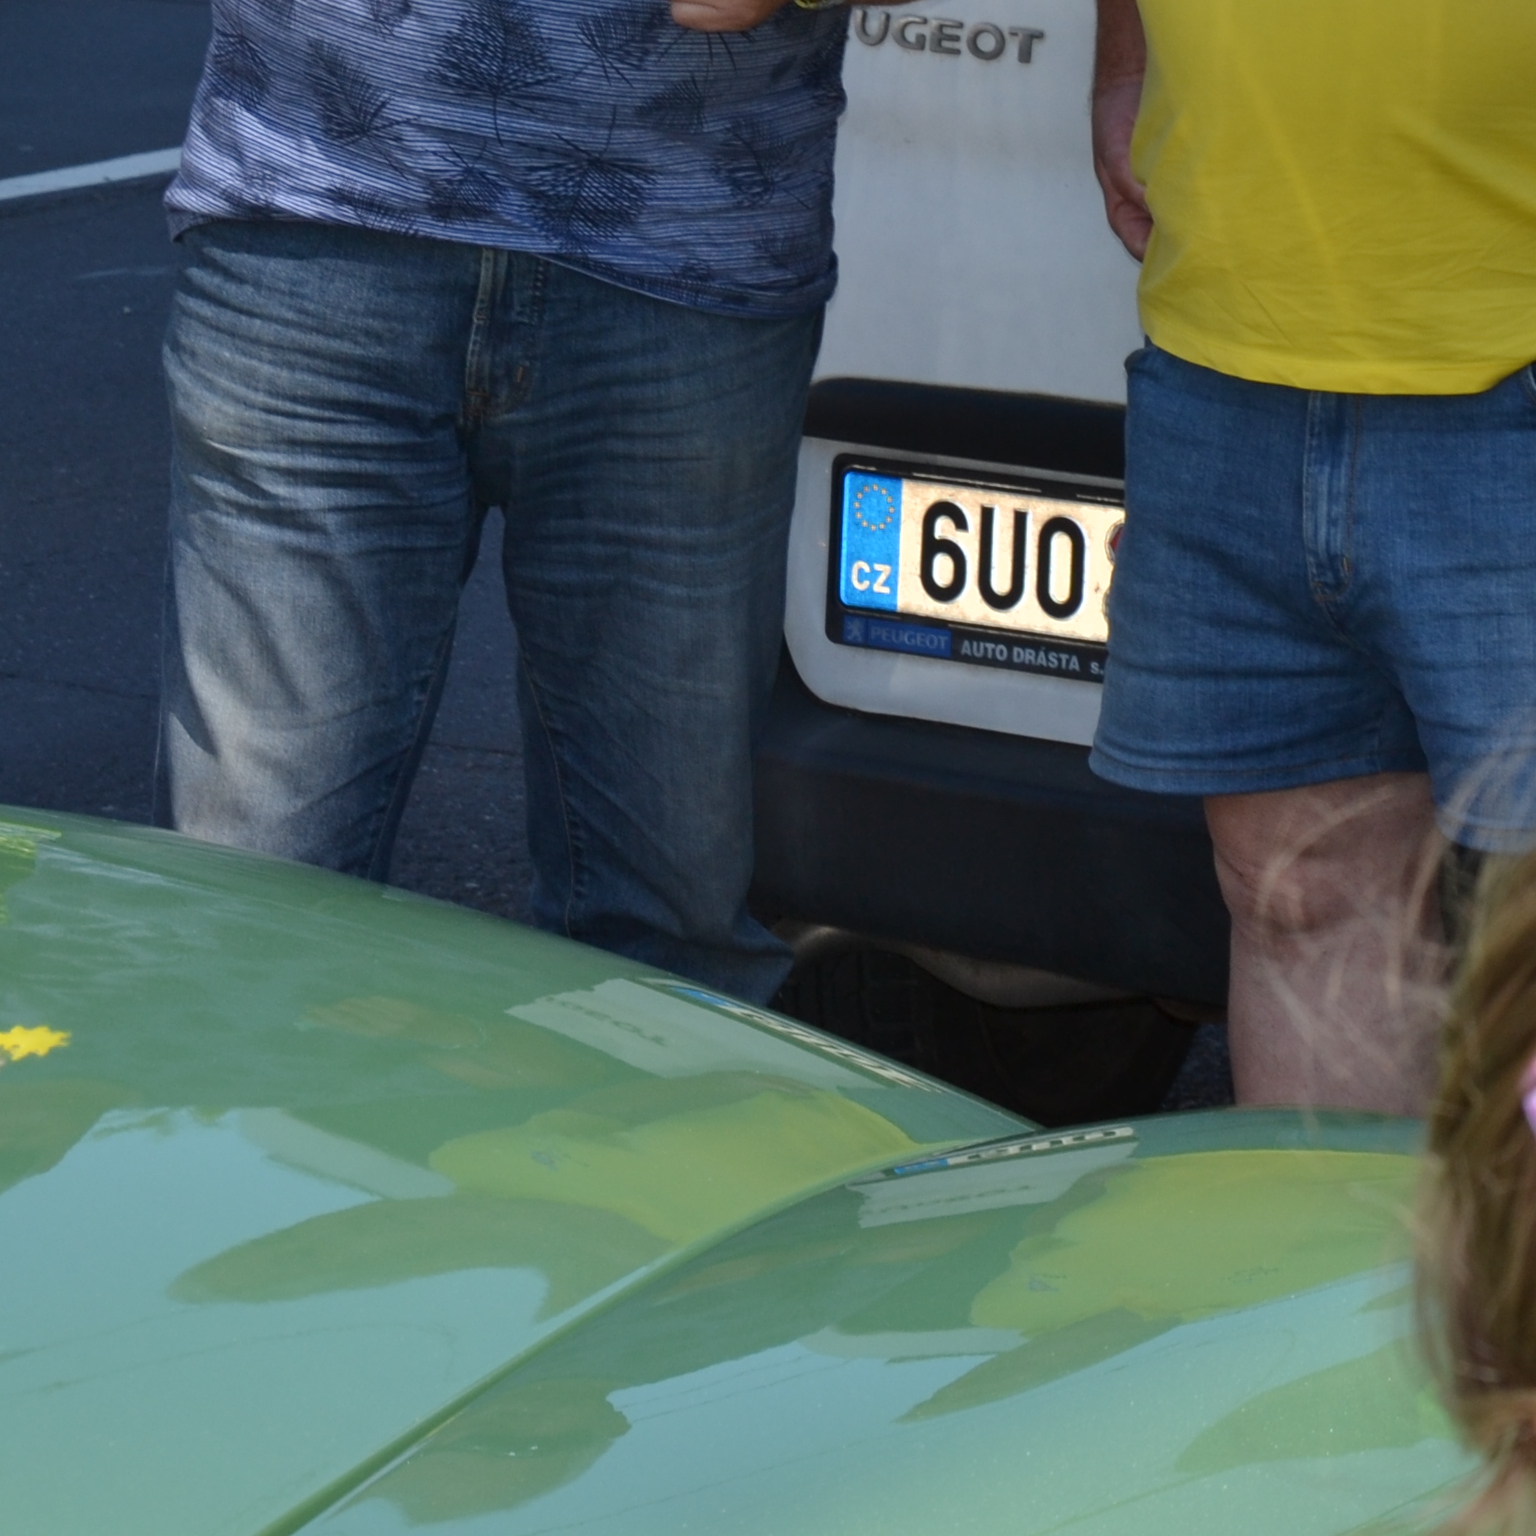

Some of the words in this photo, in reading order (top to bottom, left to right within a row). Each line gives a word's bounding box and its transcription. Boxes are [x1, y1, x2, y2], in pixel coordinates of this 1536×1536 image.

[850, 560, 891, 594] CZ
[870, 625, 950, 652] PEUGEOT
[960, 639, 1007, 662] AUTO
[1012, 644, 1081, 672] DRÁSTA
